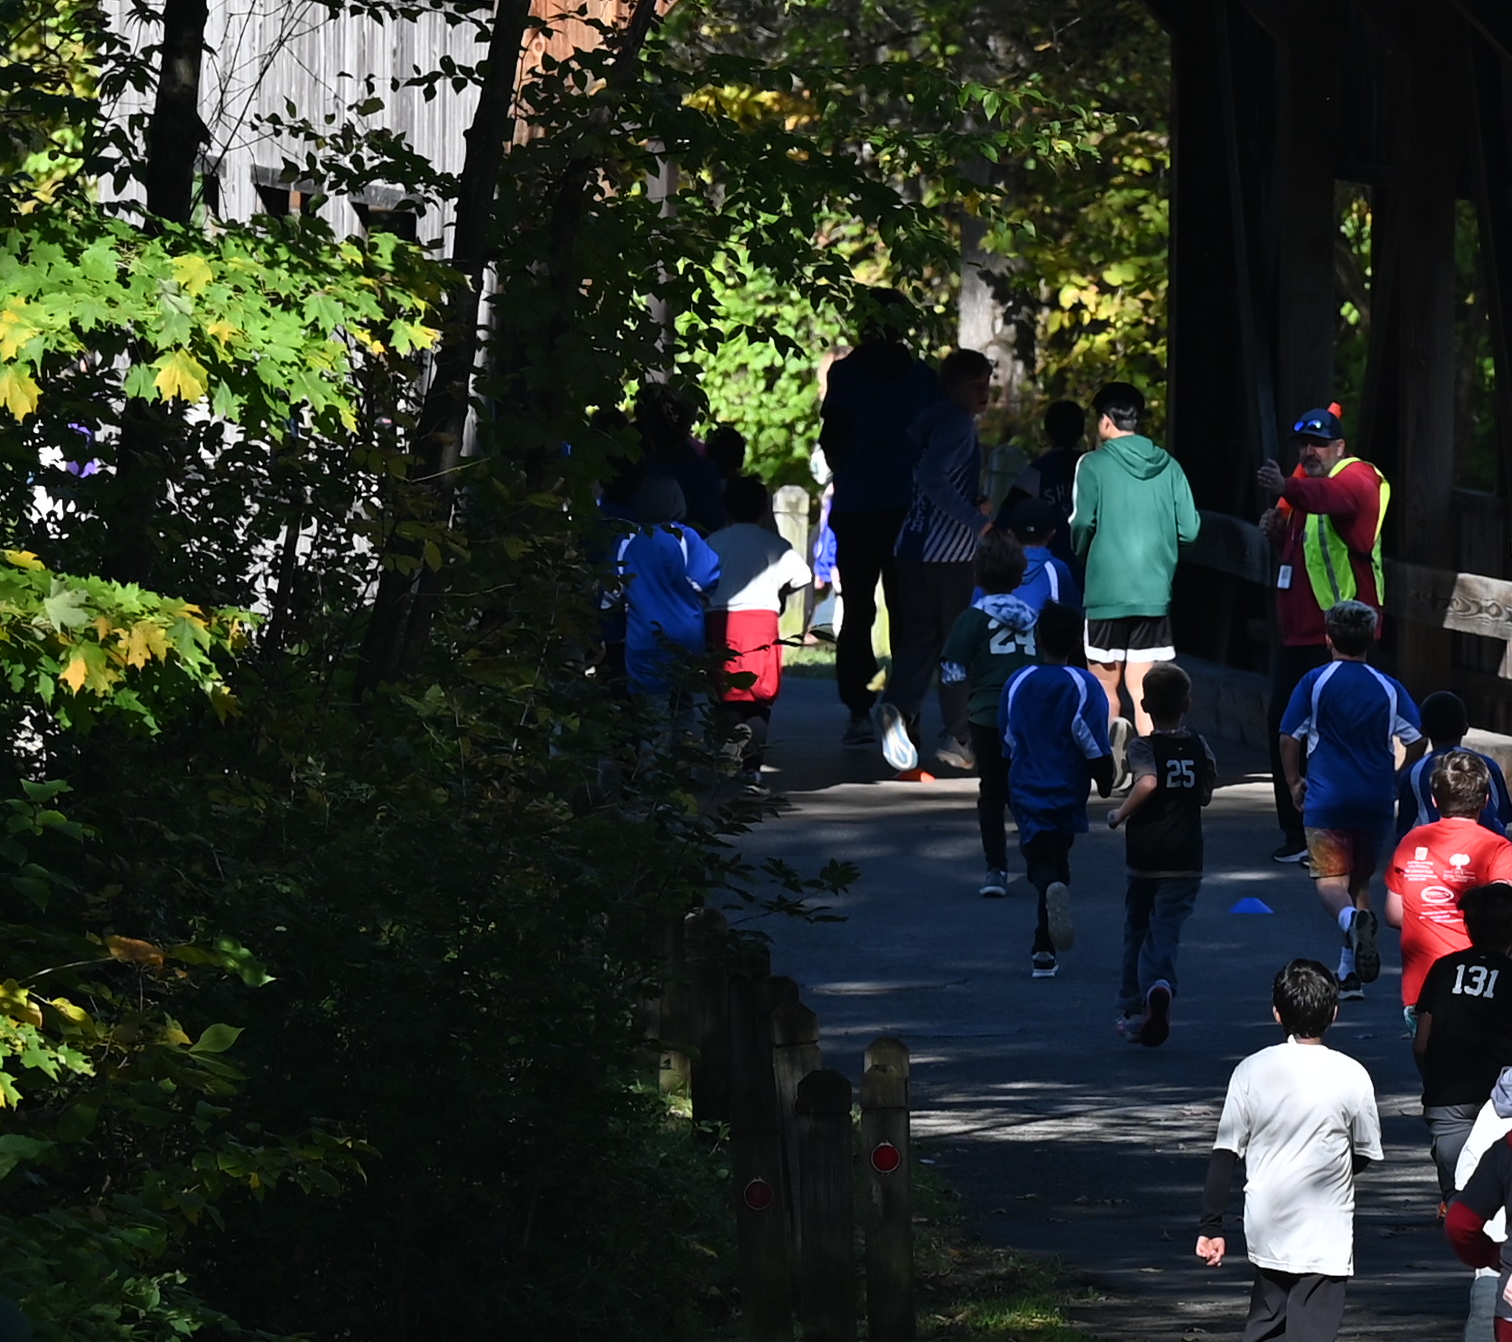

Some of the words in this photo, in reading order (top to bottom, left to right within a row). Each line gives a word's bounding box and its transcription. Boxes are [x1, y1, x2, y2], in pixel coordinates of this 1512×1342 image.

[988, 618, 1036, 657] 24
[1166, 759, 1196, 788] 25
[1451, 964, 1500, 999] 131
